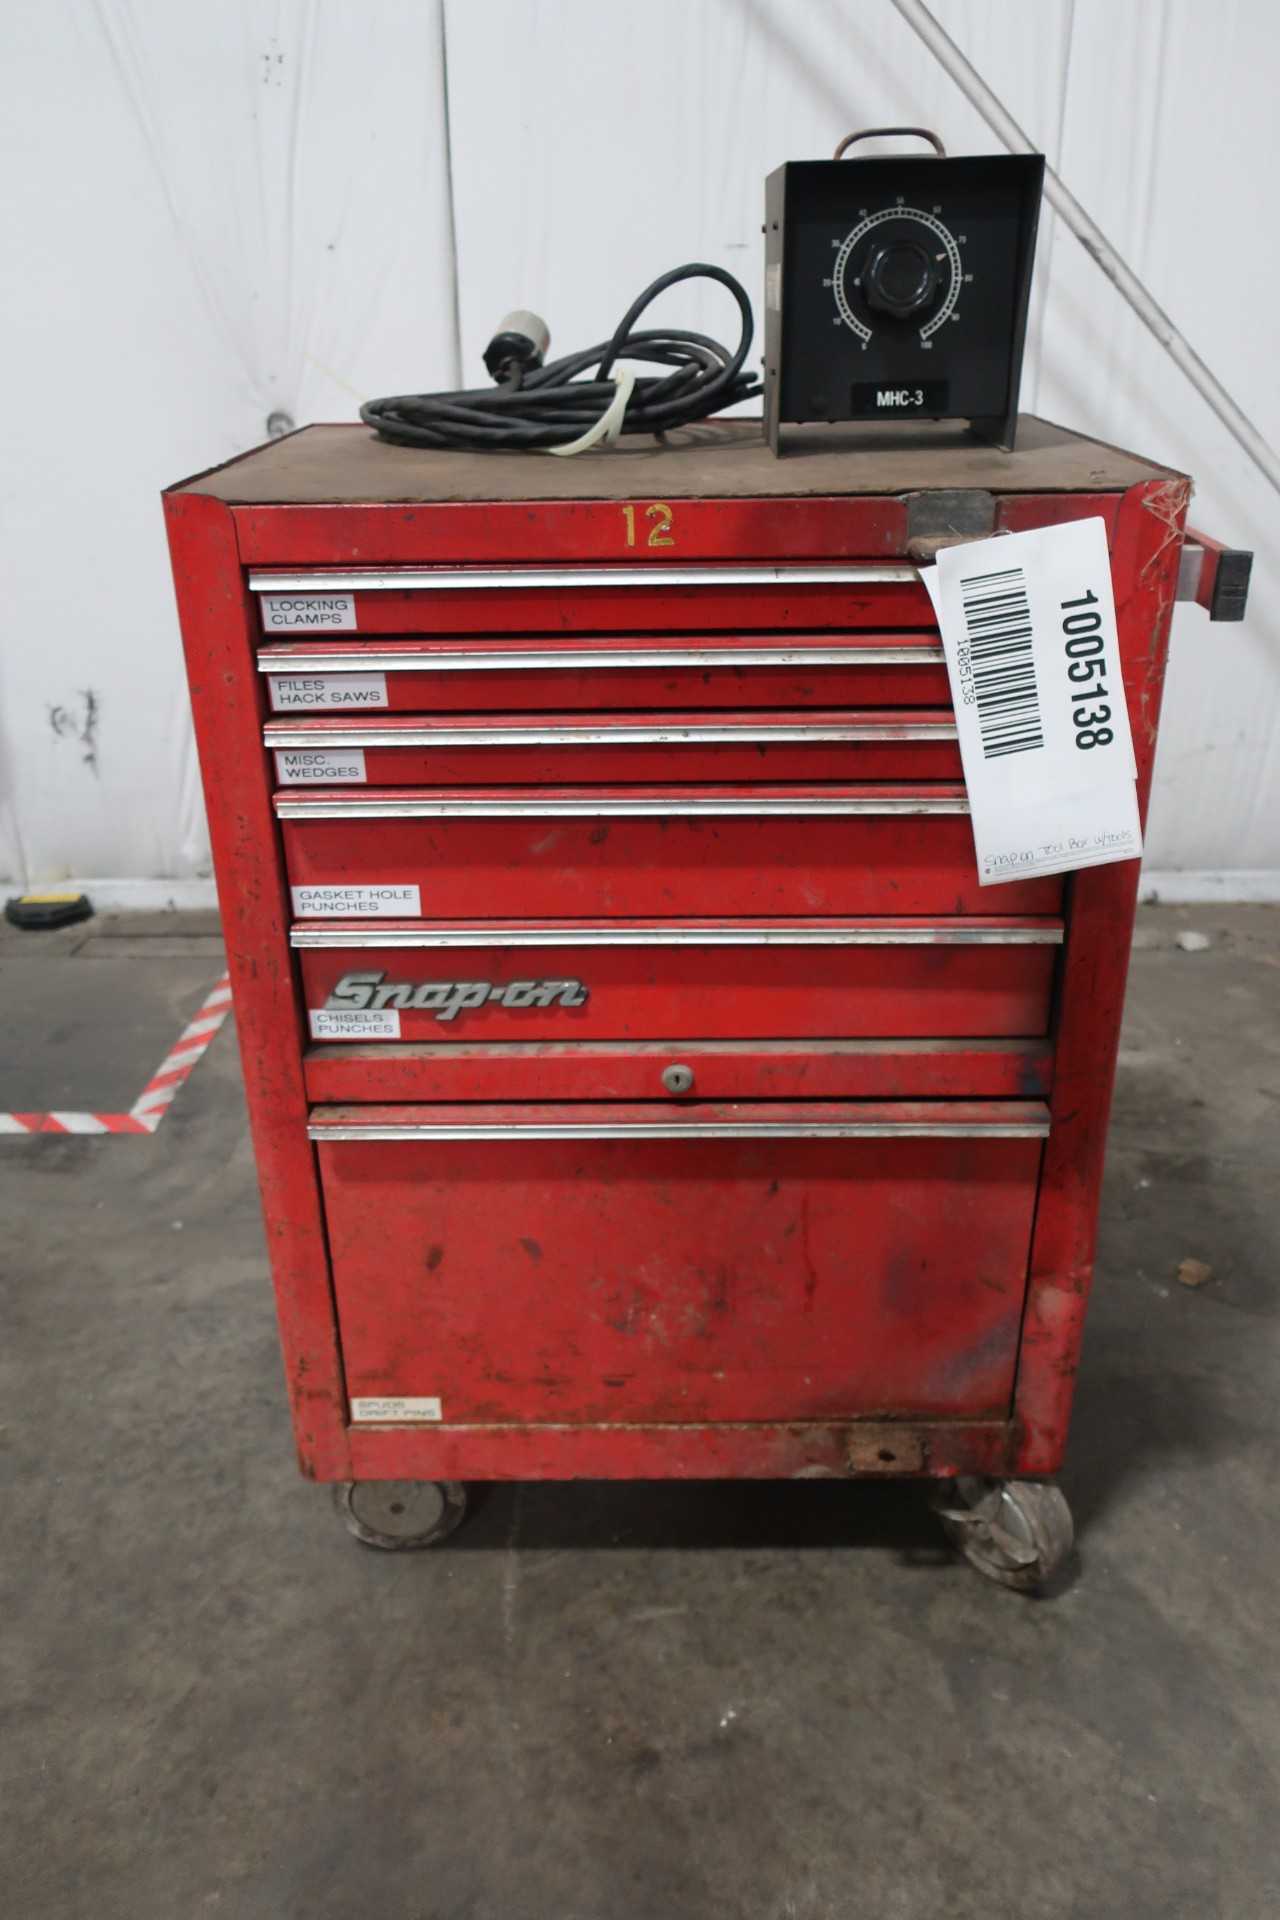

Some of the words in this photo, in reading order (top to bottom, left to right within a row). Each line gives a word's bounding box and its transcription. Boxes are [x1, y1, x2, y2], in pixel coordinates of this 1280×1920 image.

[876, 390, 924, 407] MHC-3
[621, 502, 676, 547] 12
[269, 599, 349, 613] LOCKING
[271, 612, 343, 626] CLAMPS
[956, 638, 977, 706] 1005138
[1060, 588, 1114, 751] 1005138
[277, 679, 326, 692] FILES
[279, 692, 326, 705] HACK
[331, 690, 381, 703] SAWS
[284, 754, 331, 766] MISC.
[285, 766, 360, 779] WEDGES
[299, 889, 363, 901] GASKET
[368, 889, 414, 900] HOLE
[300, 901, 380, 912] PUNCHES
[324, 970, 592, 1021] Snap-on
[316, 1013, 385, 1024] CHISELS
[317, 1023, 395, 1034] PUNCHES
